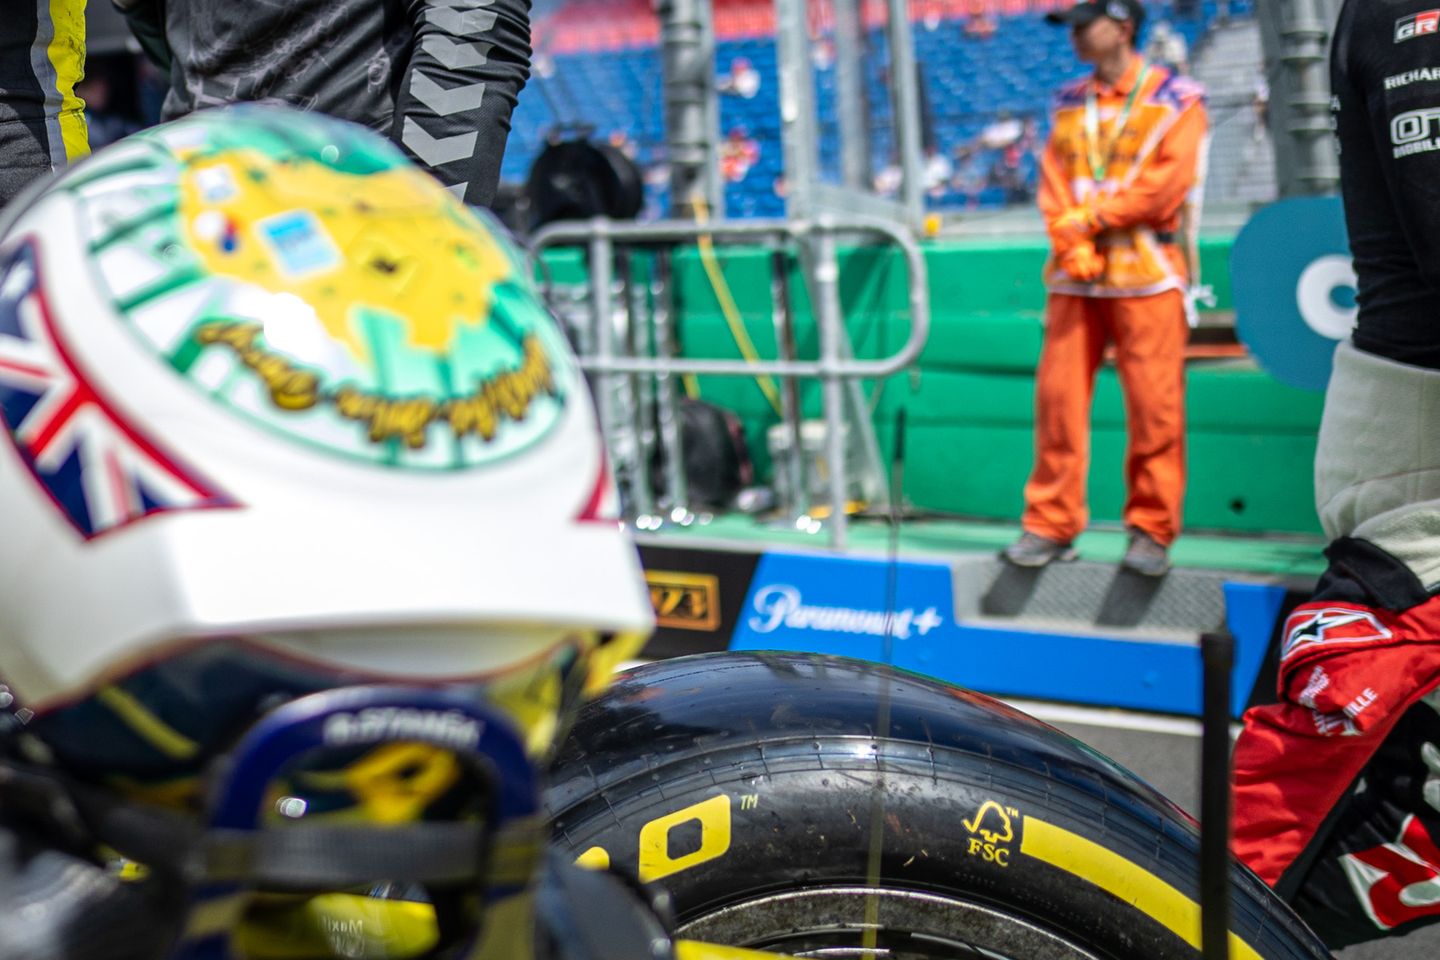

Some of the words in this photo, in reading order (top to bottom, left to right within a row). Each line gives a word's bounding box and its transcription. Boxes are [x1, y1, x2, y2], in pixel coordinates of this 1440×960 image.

[1397, 18, 1436, 40] GR
[749, 584, 944, 639] Paramount+
[967, 837, 1010, 867] FSC
